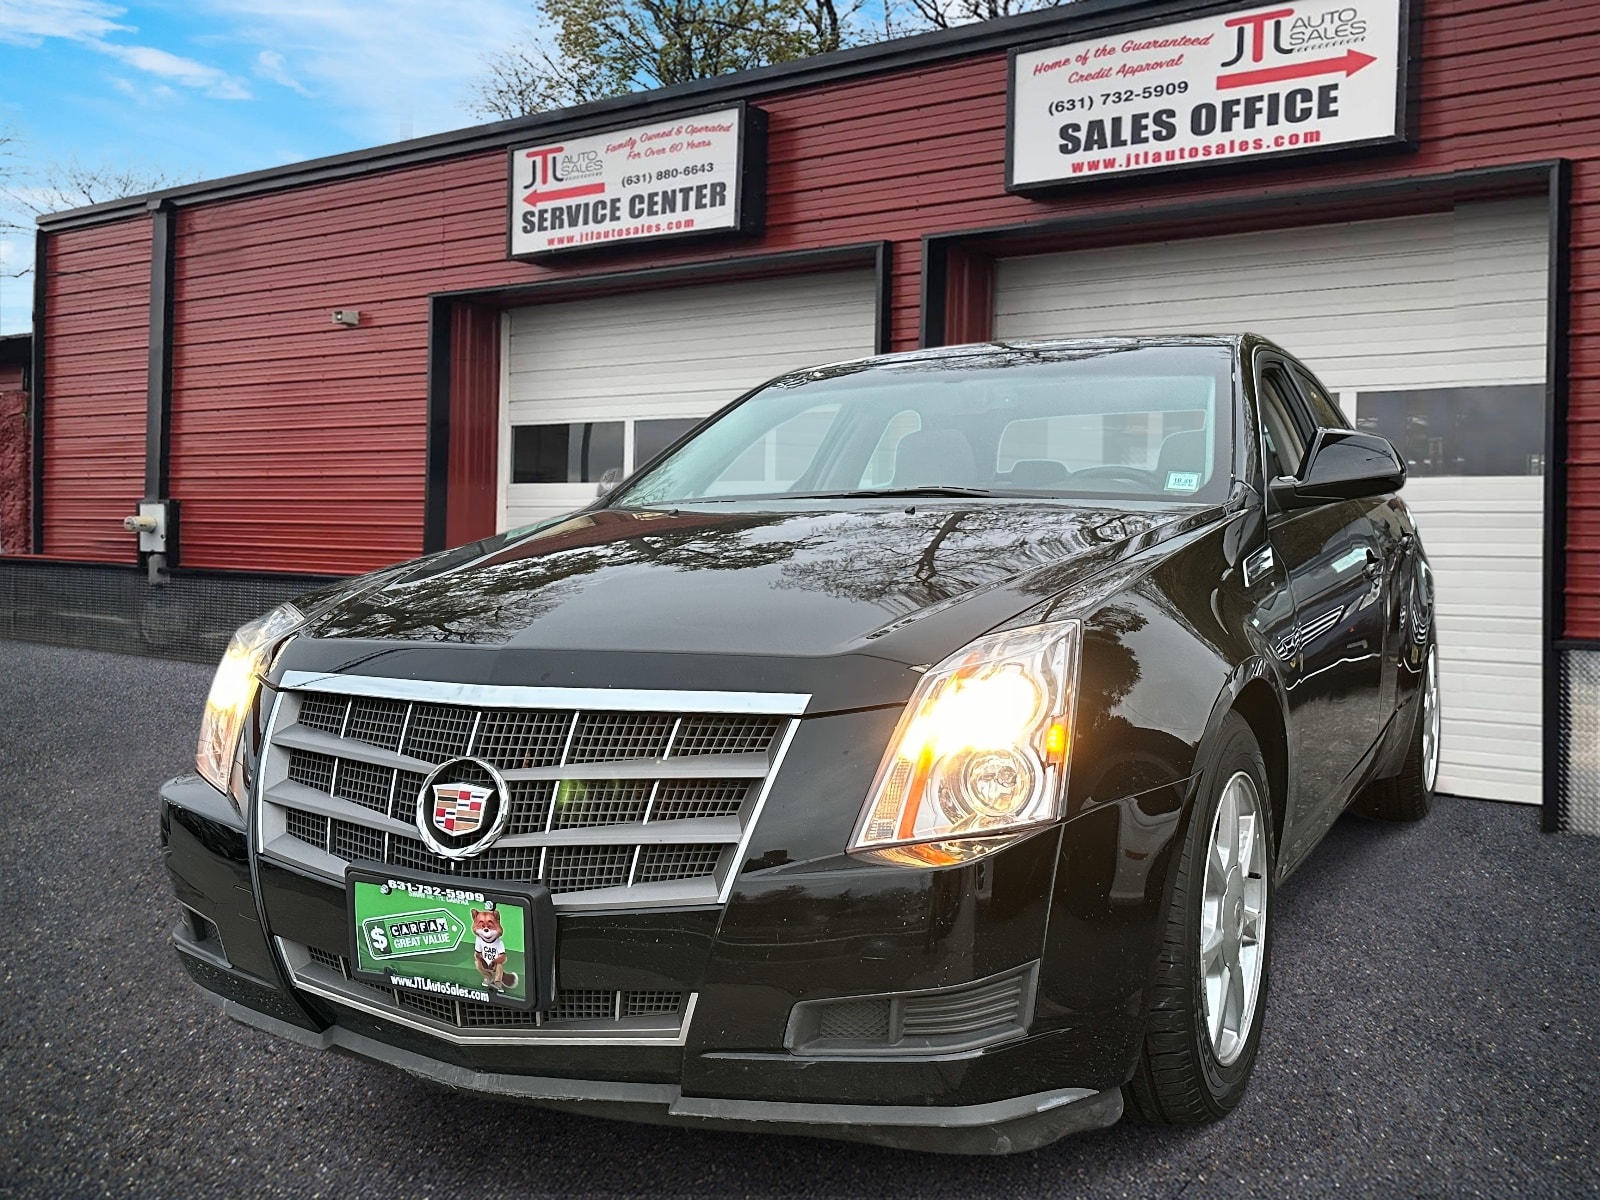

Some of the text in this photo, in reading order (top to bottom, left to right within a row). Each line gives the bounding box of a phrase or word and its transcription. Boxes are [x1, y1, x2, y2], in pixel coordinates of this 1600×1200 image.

[1291, 8, 1357, 31] AUTO
[1289, 21, 1367, 46] SALES
[1033, 33, 1214, 76] Home of the Guaranteed
[1068, 54, 1184, 84] Credit Approval
[1048, 81, 1189, 116] (631) 732-5909
[1059, 83, 1339, 155] SALES OFFICE
[605, 123, 734, 154] Family Owned & Operated
[627, 139, 712, 160] For Over 60 Years
[561, 150, 598, 165] AUTO
[1071, 129, 1321, 174] www.jtlautosales.com
[561, 160, 603, 177] SALES
[622, 162, 714, 188] (631) 880-6643
[522, 182, 727, 234] SERVICE CENTER
[547, 217, 694, 246] www.jtlautosales.com
[387, 879, 485, 903] 631-732-5909
[390, 918, 449, 938] CARFAX
[394, 933, 450, 948] GREAT VALUE
[484, 946, 496, 954] CAR
[484, 953, 496, 961] FOX
[390, 975, 490, 1002] www.JTLAutoSales.com
